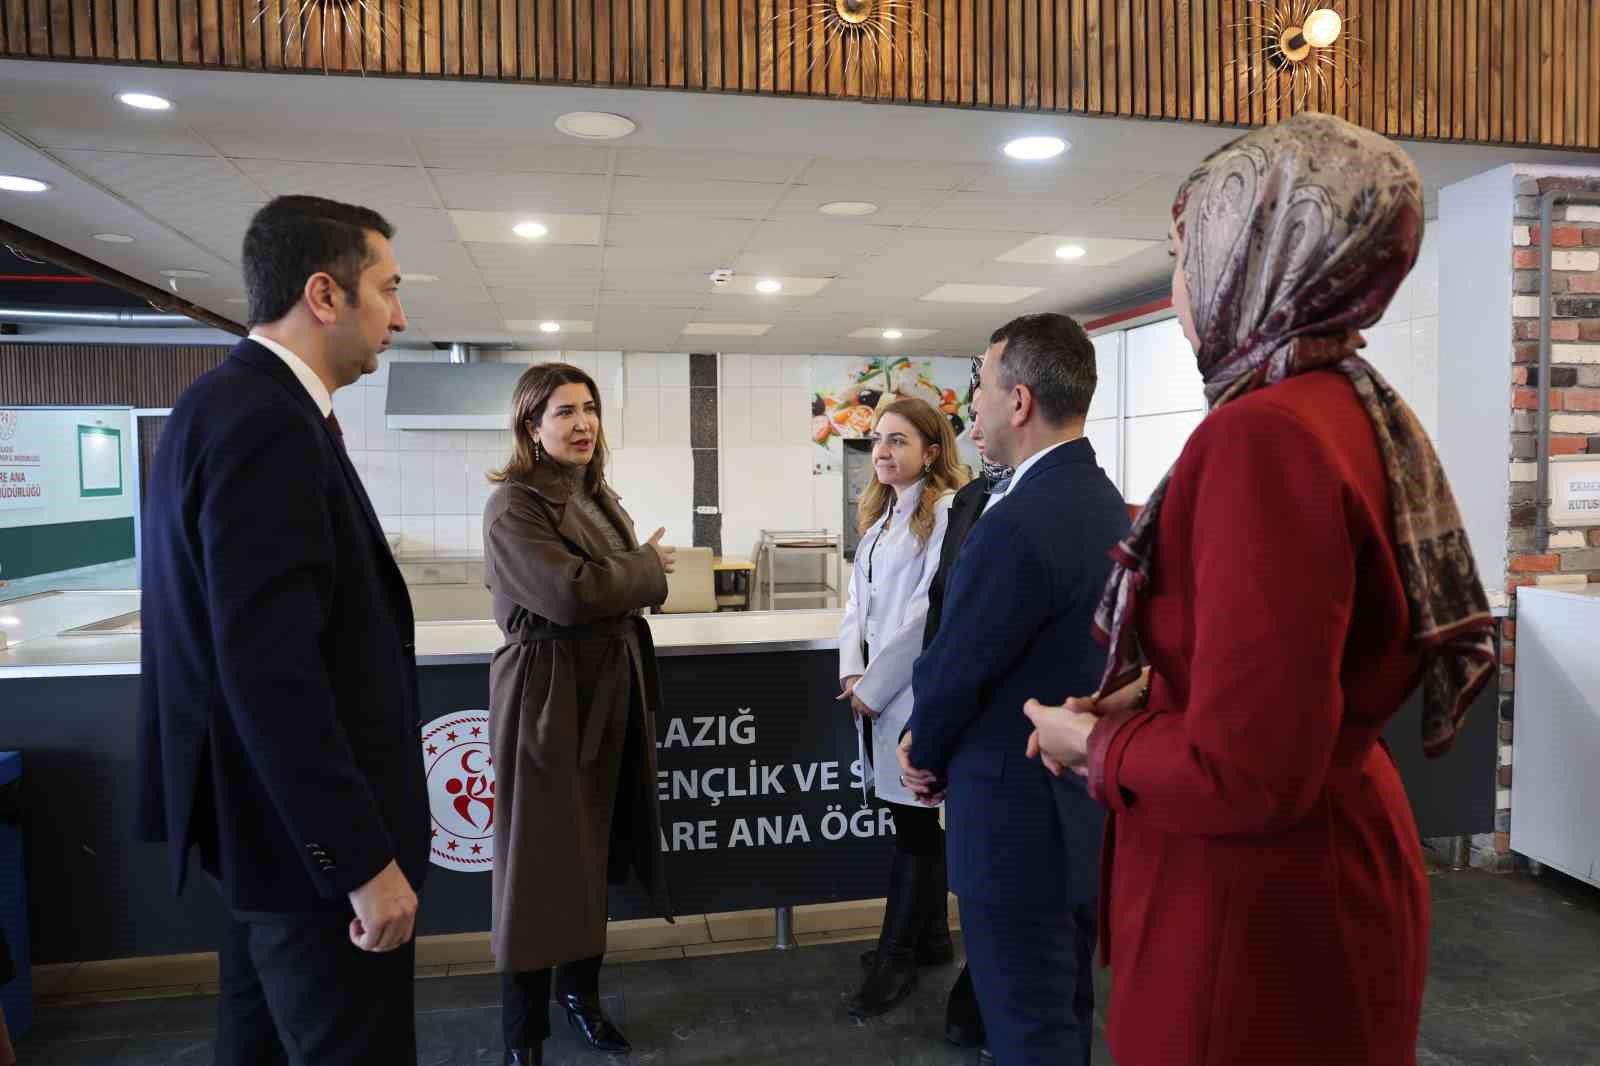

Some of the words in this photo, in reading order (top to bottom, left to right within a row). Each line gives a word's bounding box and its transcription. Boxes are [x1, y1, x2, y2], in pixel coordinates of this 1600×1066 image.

[10, 472, 26, 482] ANA
[656, 707, 756, 748] AZIĞ
[792, 761, 840, 792] VE
[727, 813, 812, 848] ANA
